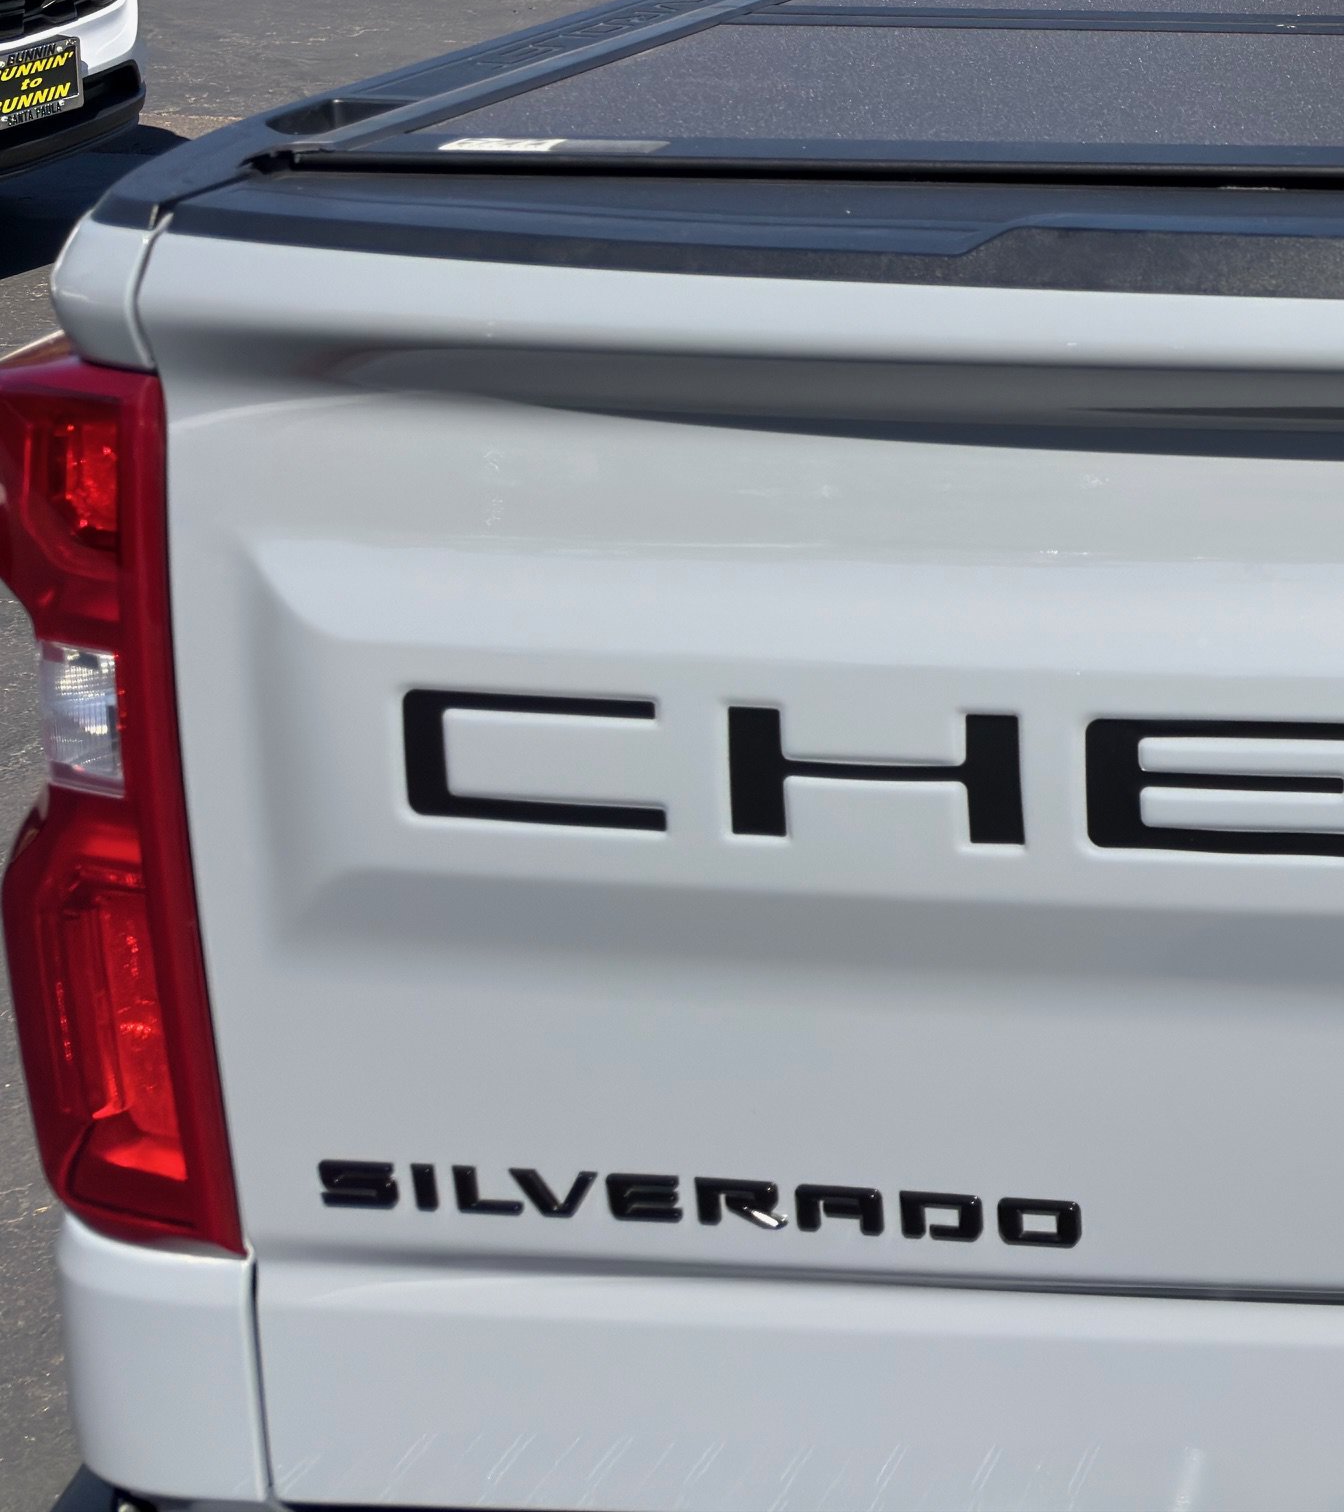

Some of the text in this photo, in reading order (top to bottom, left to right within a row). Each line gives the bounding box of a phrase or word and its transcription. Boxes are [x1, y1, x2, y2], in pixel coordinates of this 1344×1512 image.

[0, 51, 75, 82] UNNIN'
[6, 43, 57, 66] BUNNIN
[0, 82, 71, 114] UNNIN
[20, 77, 43, 91] to
[8, 100, 64, 127] SANTA PAULA
[317, 1158, 1083, 1249] SILVERADO
